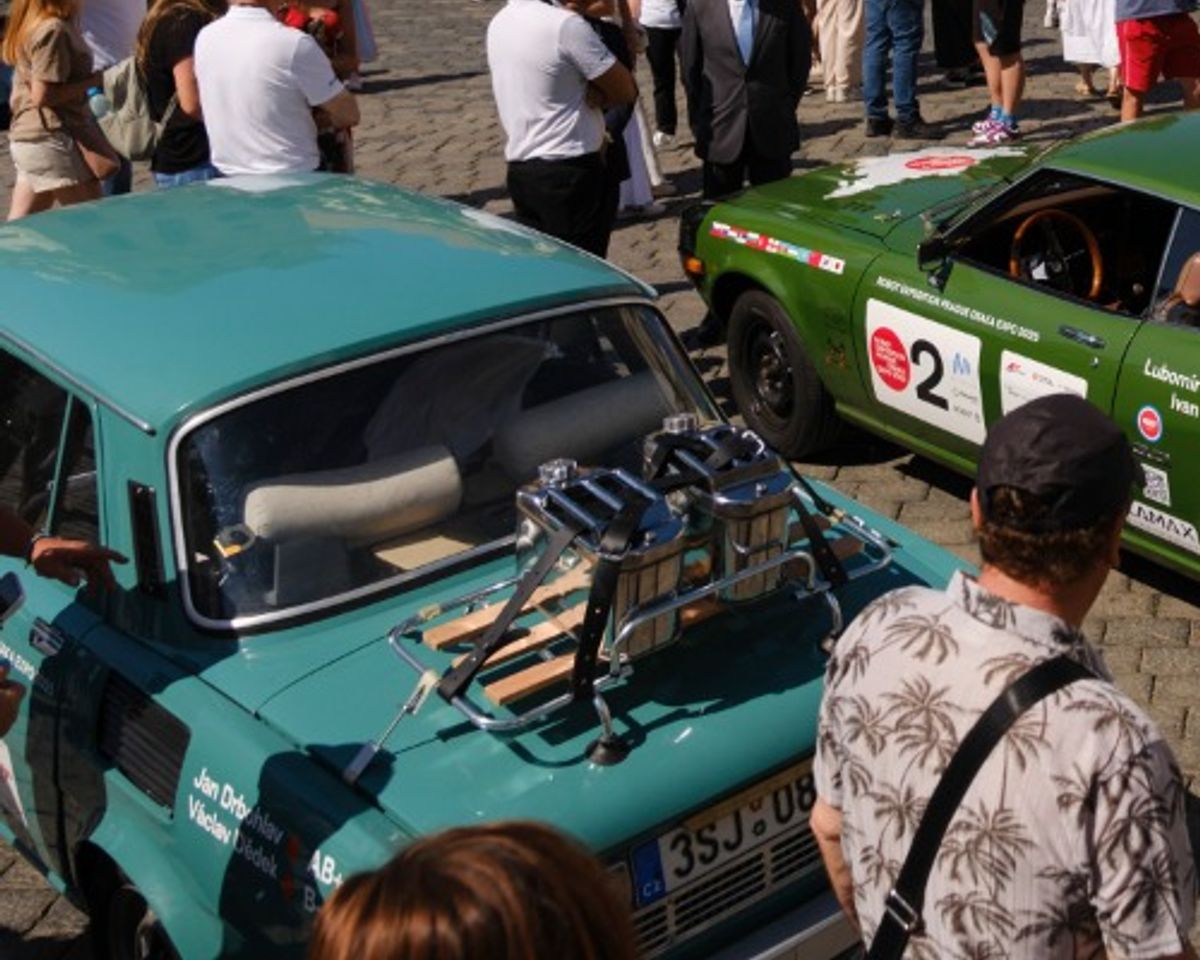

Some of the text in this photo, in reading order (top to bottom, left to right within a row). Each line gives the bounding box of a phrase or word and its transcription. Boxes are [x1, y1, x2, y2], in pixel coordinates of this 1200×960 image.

[910, 338, 949, 412] 2
[1170, 391, 1199, 419] Ivan
[188, 794, 232, 844] Václav
[193, 767, 284, 844] Jan Drbohlav
[669, 809, 744, 879] 3SJ
